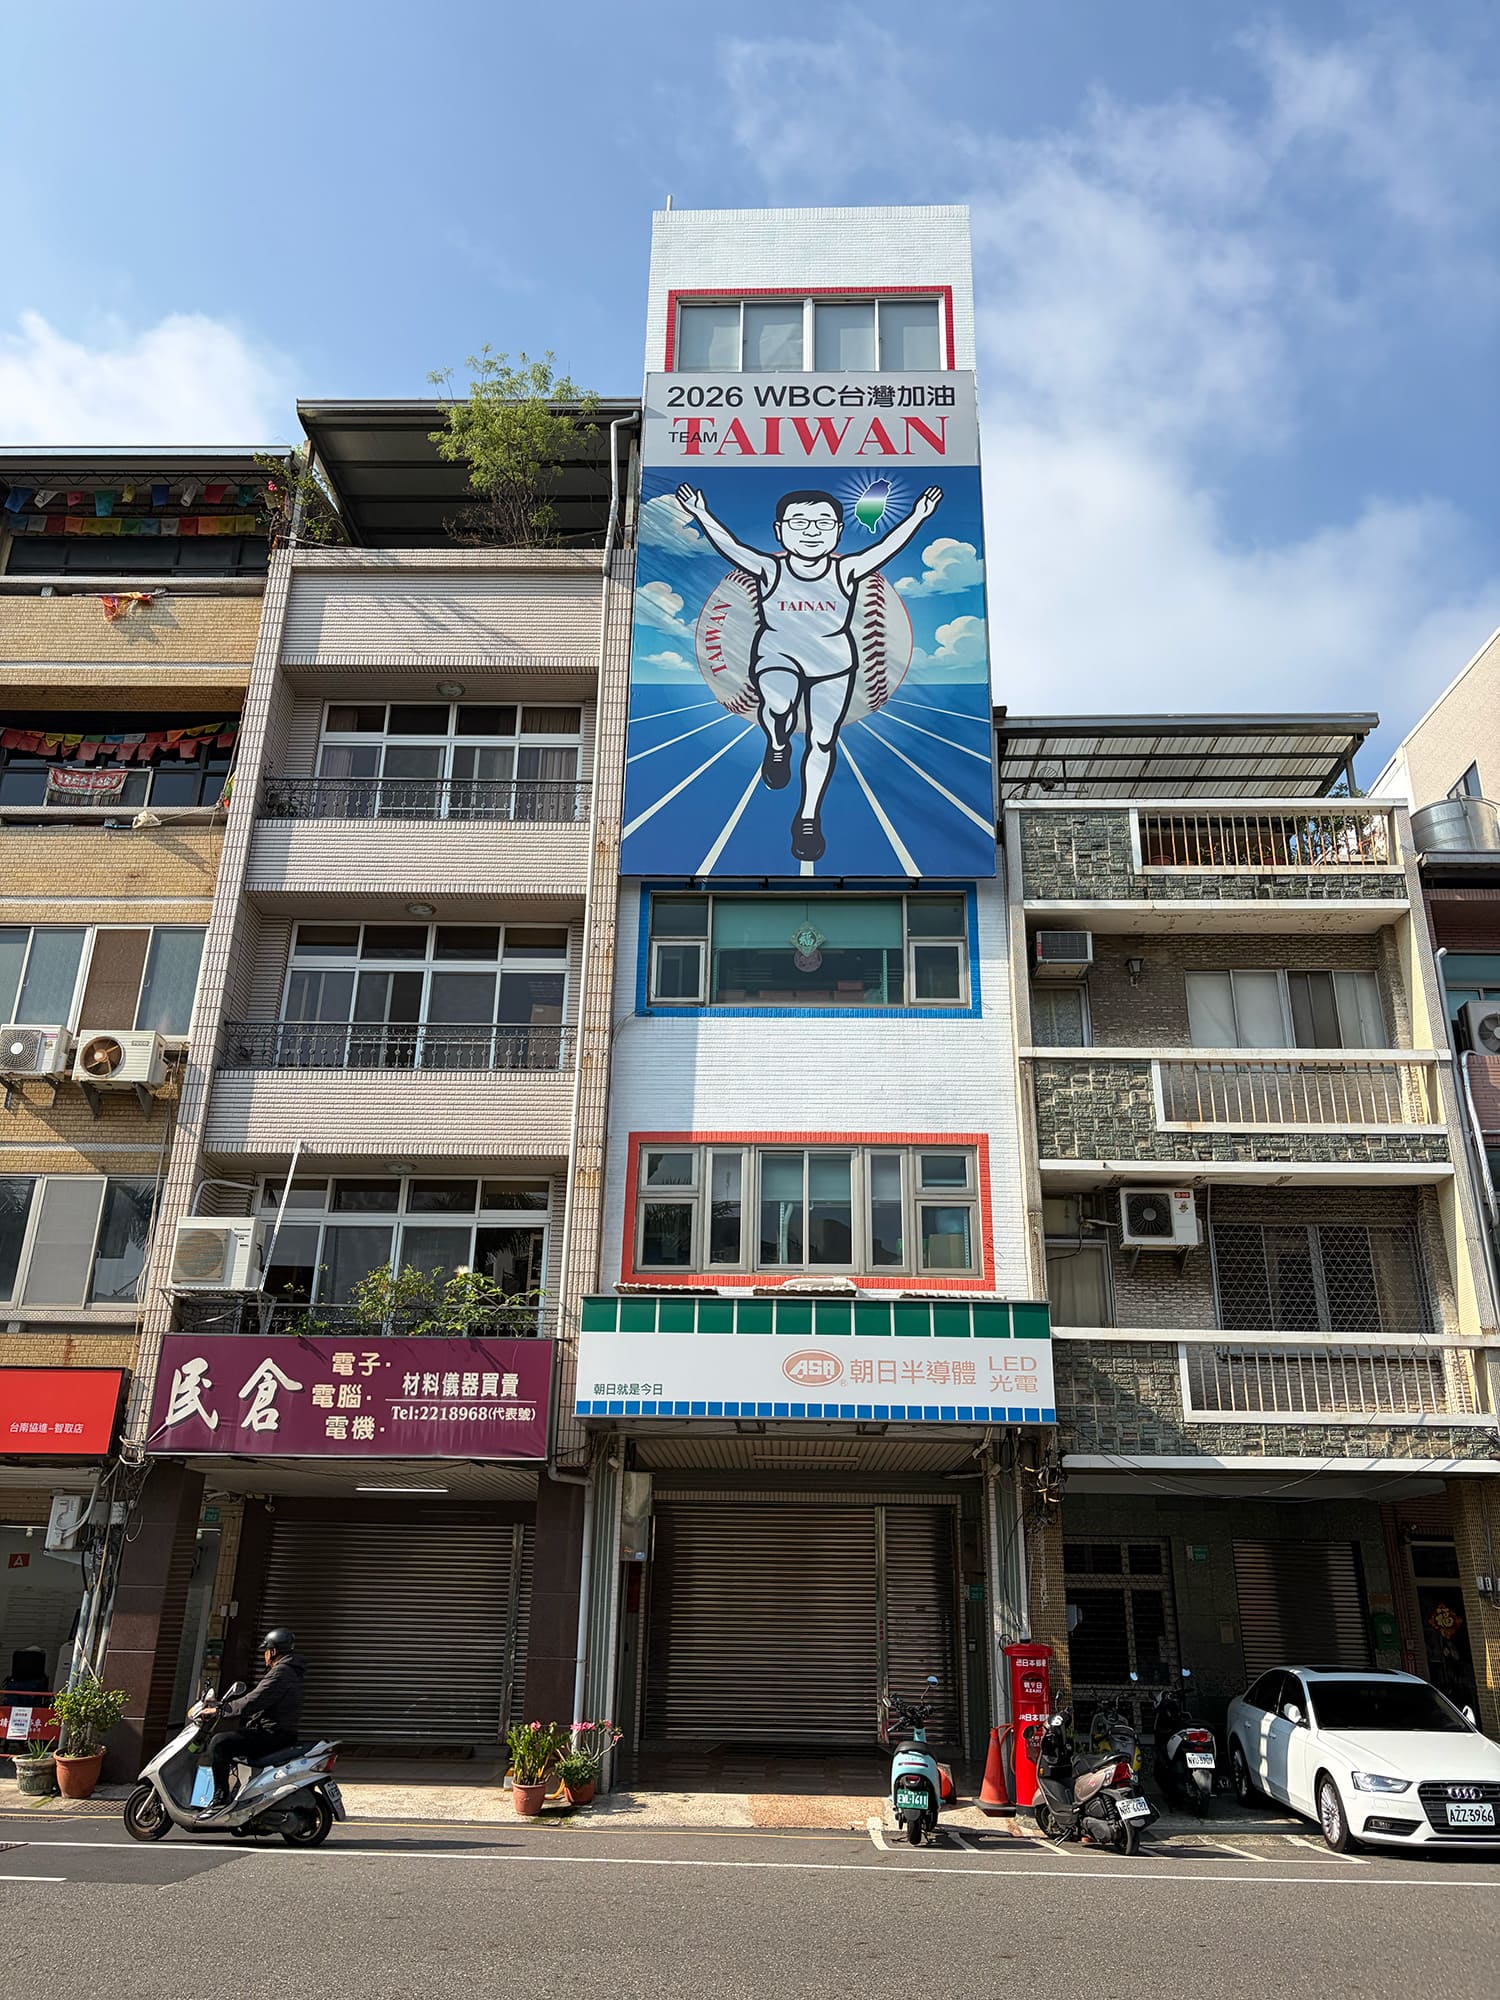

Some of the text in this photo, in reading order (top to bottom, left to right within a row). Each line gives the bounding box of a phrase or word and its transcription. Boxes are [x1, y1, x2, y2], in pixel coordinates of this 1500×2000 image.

[667, 385, 744, 407] 2026
[668, 415, 951, 456] TEAM TAIWAN
[777, 600, 837, 612] TAINAN
[704, 599, 733, 677] TAIWAN
[850, 1359, 977, 1386] 朝日半導體
[988, 1355, 1038, 1373] LED
[402, 1371, 519, 1398] 材料儀器買賣
[593, 1383, 664, 1397] 朝日就是今日
[990, 1374, 1039, 1394] 光電
[13, 1555, 24, 1567] A
[1450, 1808, 1494, 1823] AZZ-3966
